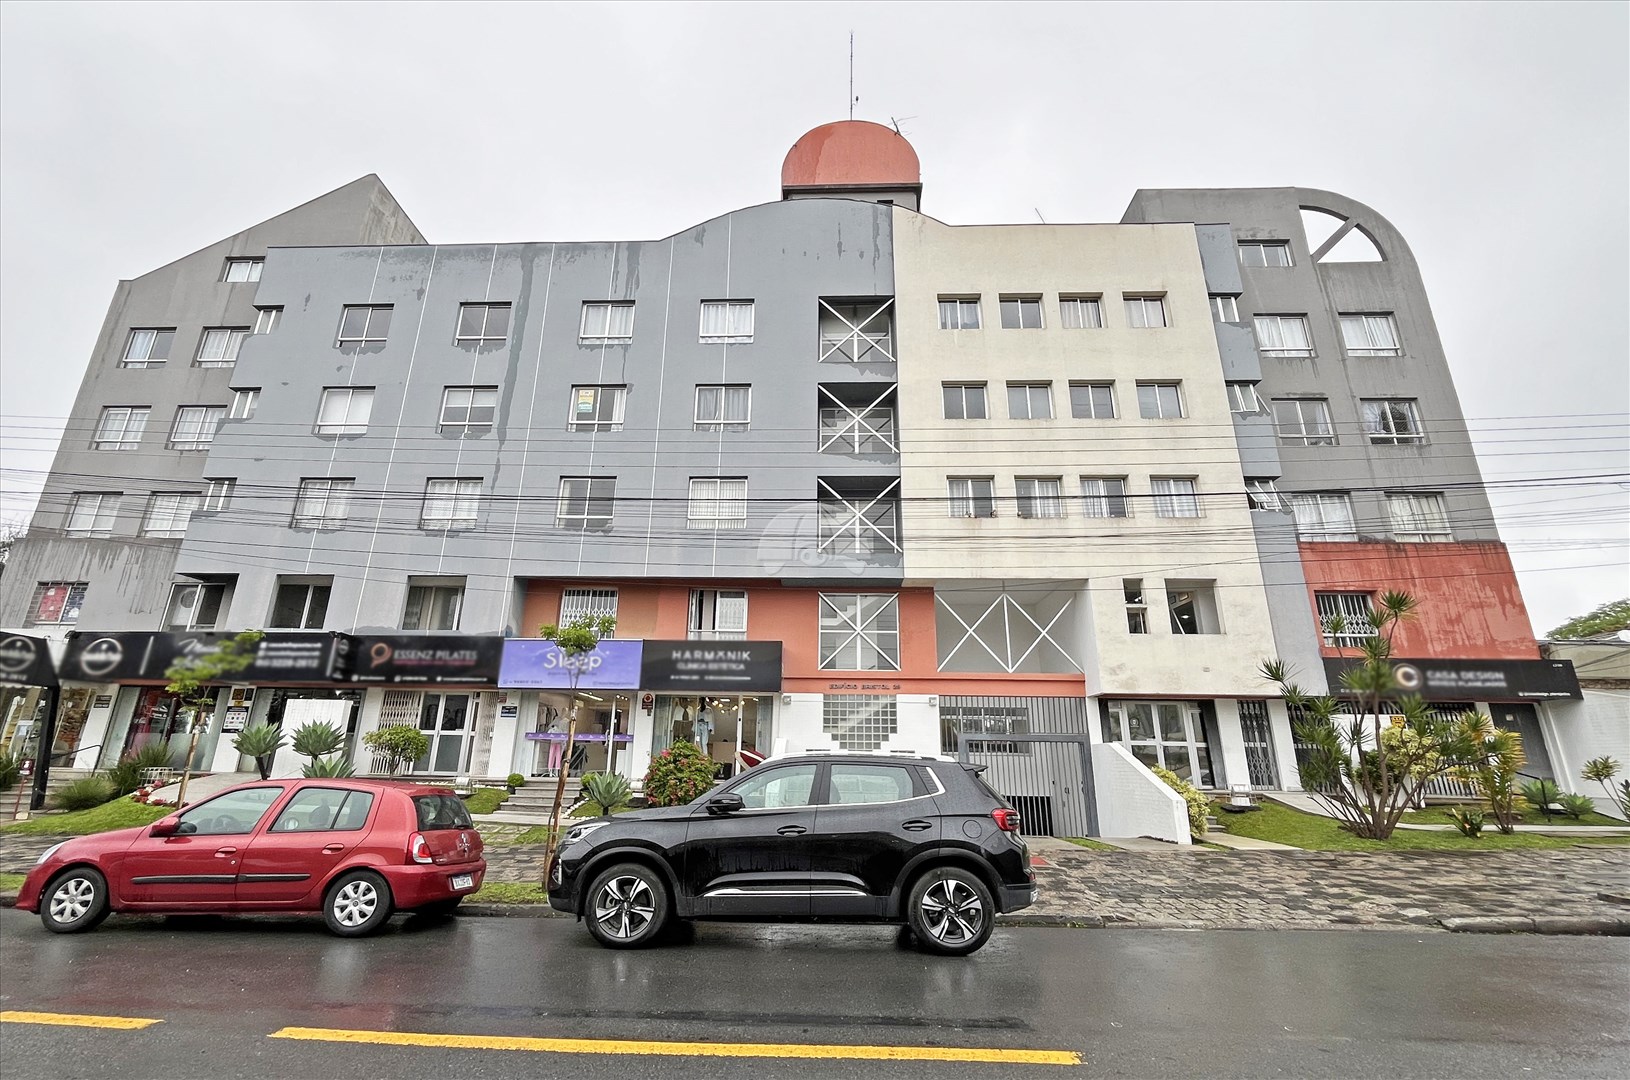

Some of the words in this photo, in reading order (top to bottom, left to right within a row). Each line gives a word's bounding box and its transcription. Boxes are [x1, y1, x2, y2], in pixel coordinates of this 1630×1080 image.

[393, 649, 433, 660] ESSENZ
[435, 650, 477, 660] PILATES
[543, 652, 602, 671] Sleep
[1426, 670, 1459, 680] CASA
[1460, 671, 1505, 681] DESIGN
